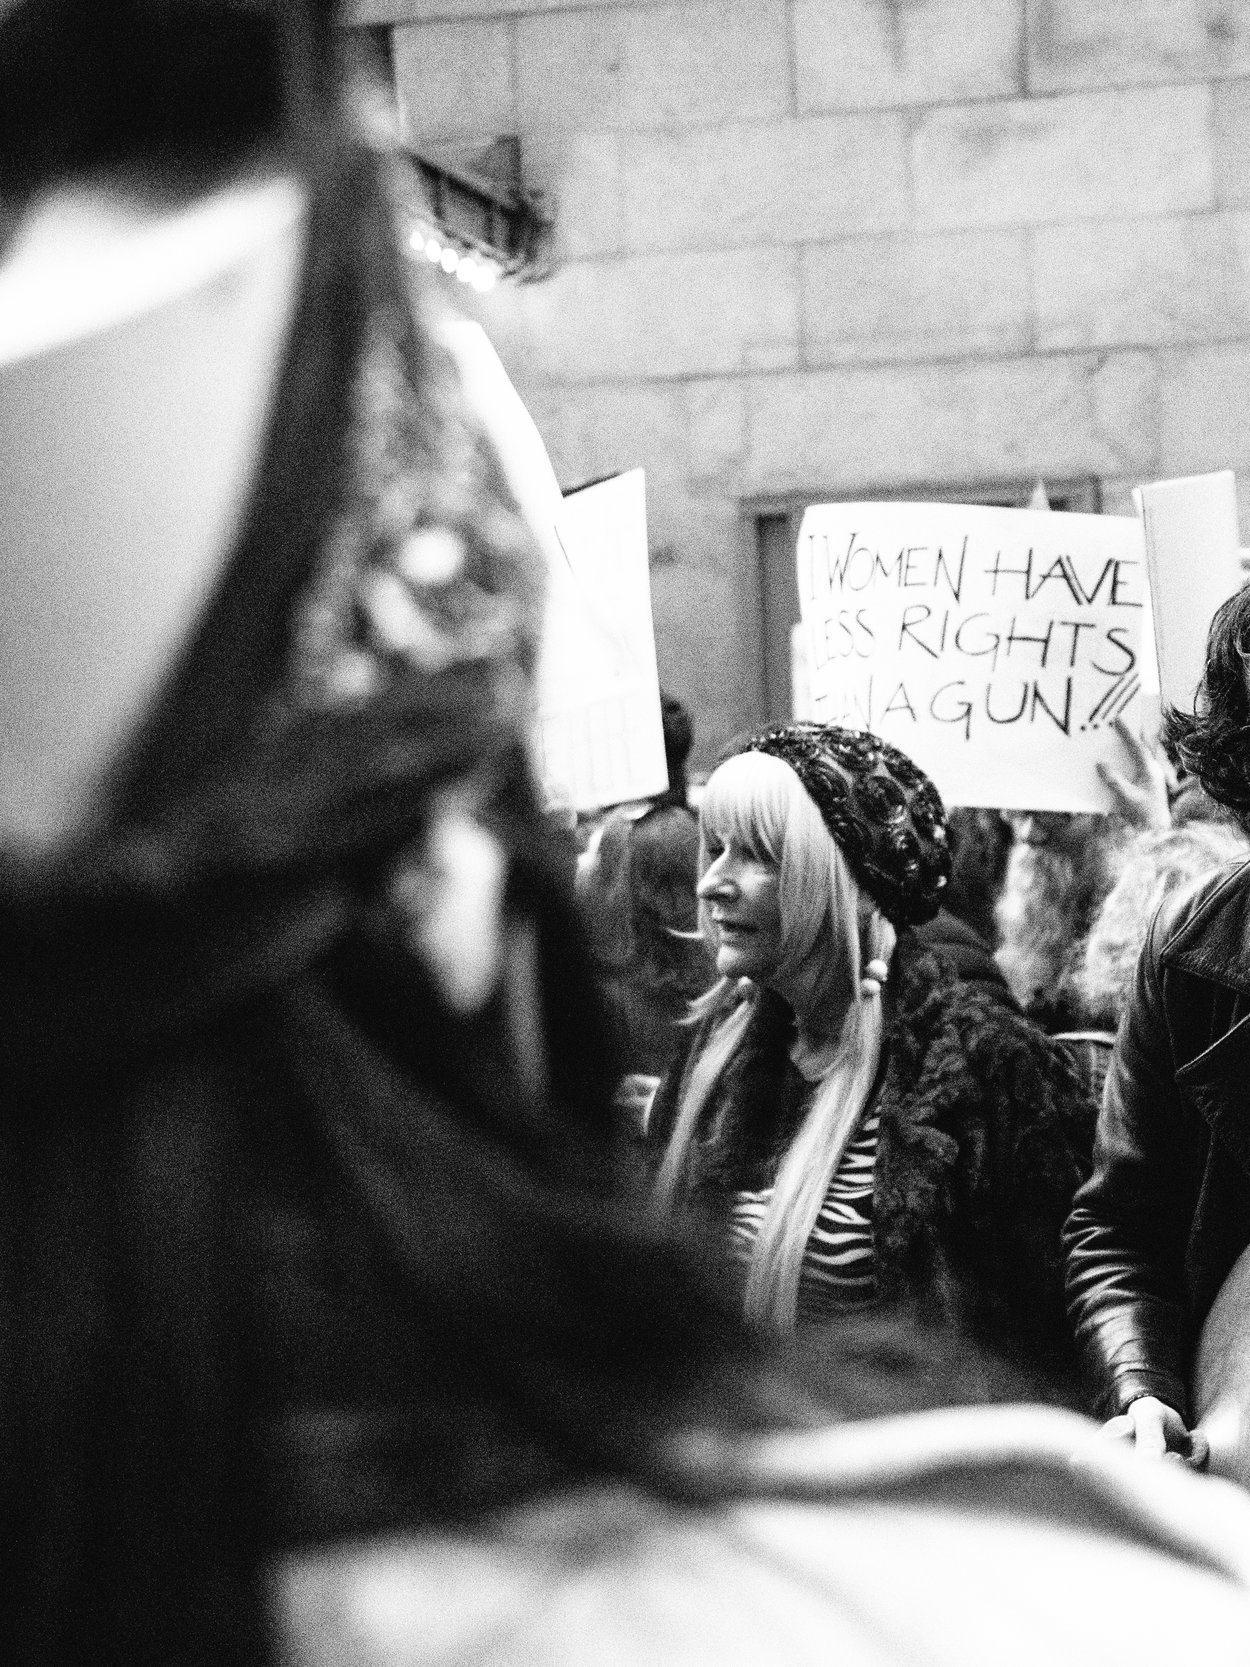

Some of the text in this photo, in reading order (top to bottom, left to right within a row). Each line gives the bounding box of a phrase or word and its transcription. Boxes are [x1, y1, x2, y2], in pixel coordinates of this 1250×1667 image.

[823, 532, 968, 603] WOMEN
[984, 547, 1143, 606] HAVE
[899, 605, 1136, 676] RIGHTS
[884, 681, 917, 722] A
